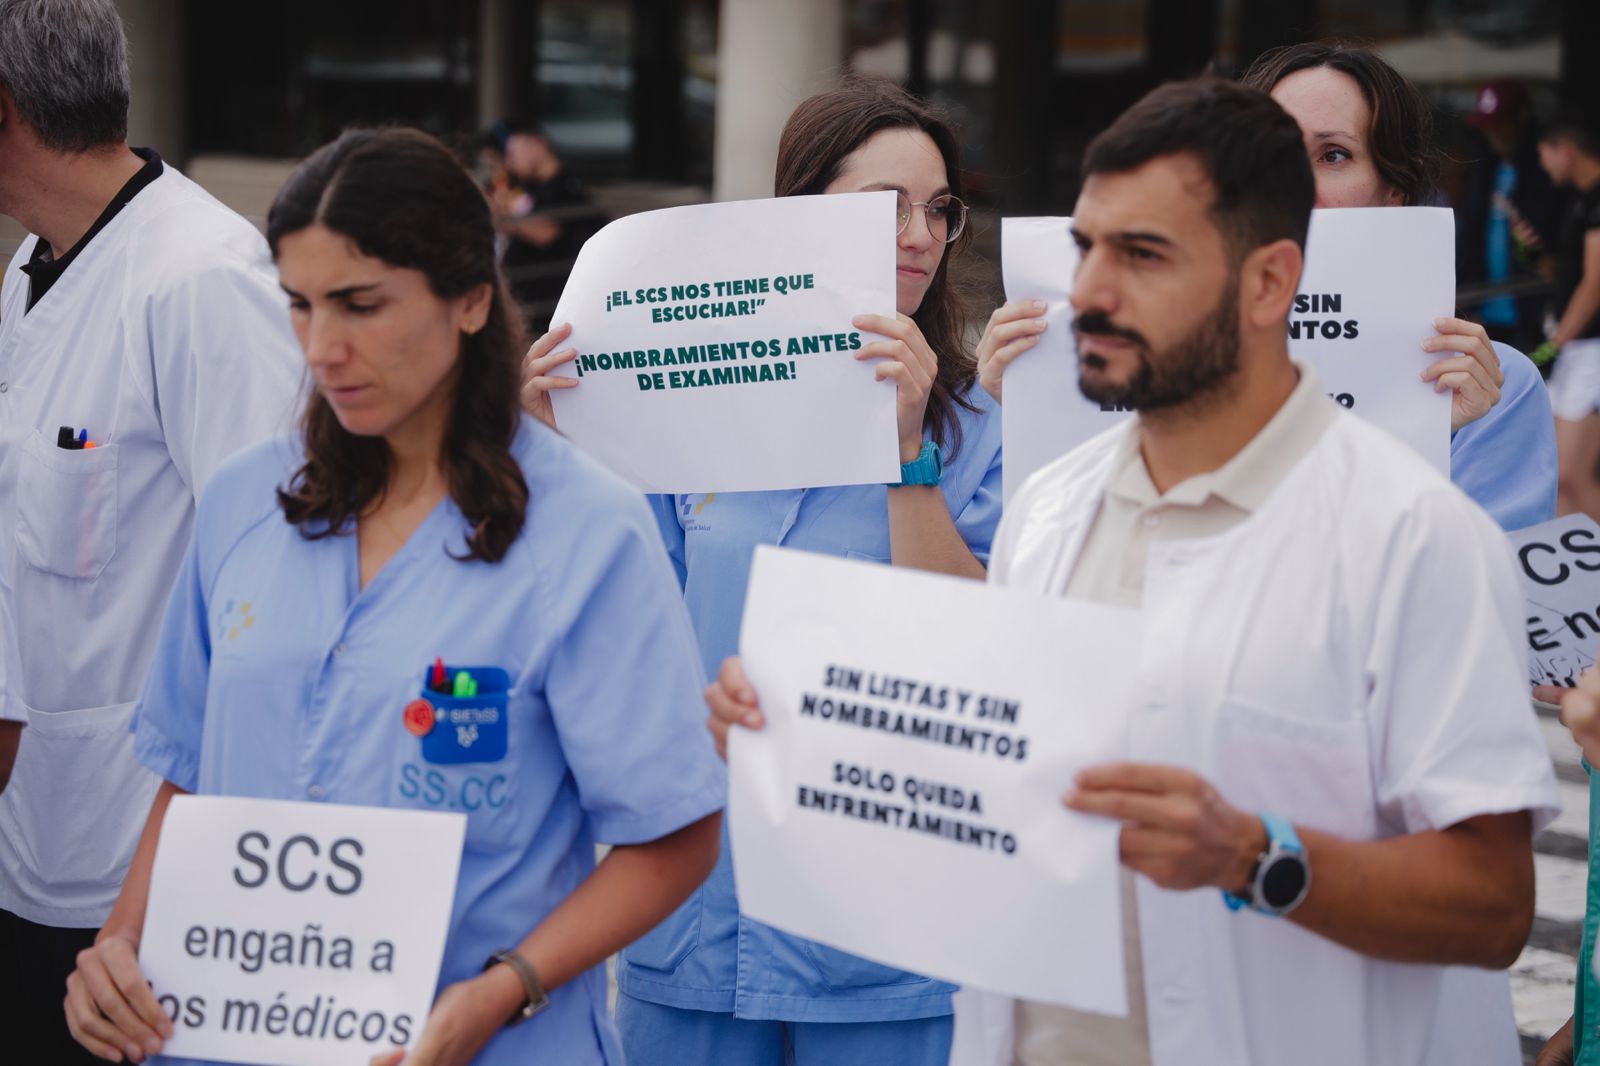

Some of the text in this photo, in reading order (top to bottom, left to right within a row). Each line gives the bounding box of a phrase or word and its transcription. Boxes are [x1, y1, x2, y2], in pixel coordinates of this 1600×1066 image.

[606, 274, 814, 312] ¡EL SCS NOS TIENE QUE
[1294, 294, 1342, 313] SIN
[575, 332, 862, 377] ¡NOMBRAMIENTOS ANTES
[1287, 320, 1359, 340] NTOS
[637, 361, 796, 391] DE EXAMINAR!
[1518, 529, 1600, 585] CS
[825, 666, 1020, 723] SIN LISTAS Y SIN
[799, 695, 1028, 760] NOMBRAMIENTOS
[834, 763, 981, 813] SOLO QUEDA
[797, 787, 1017, 854] ENFRENTAMIENTO
[233, 831, 364, 895] SCS
[184, 924, 394, 973] engaña a
[148, 980, 413, 1045] os médicos
